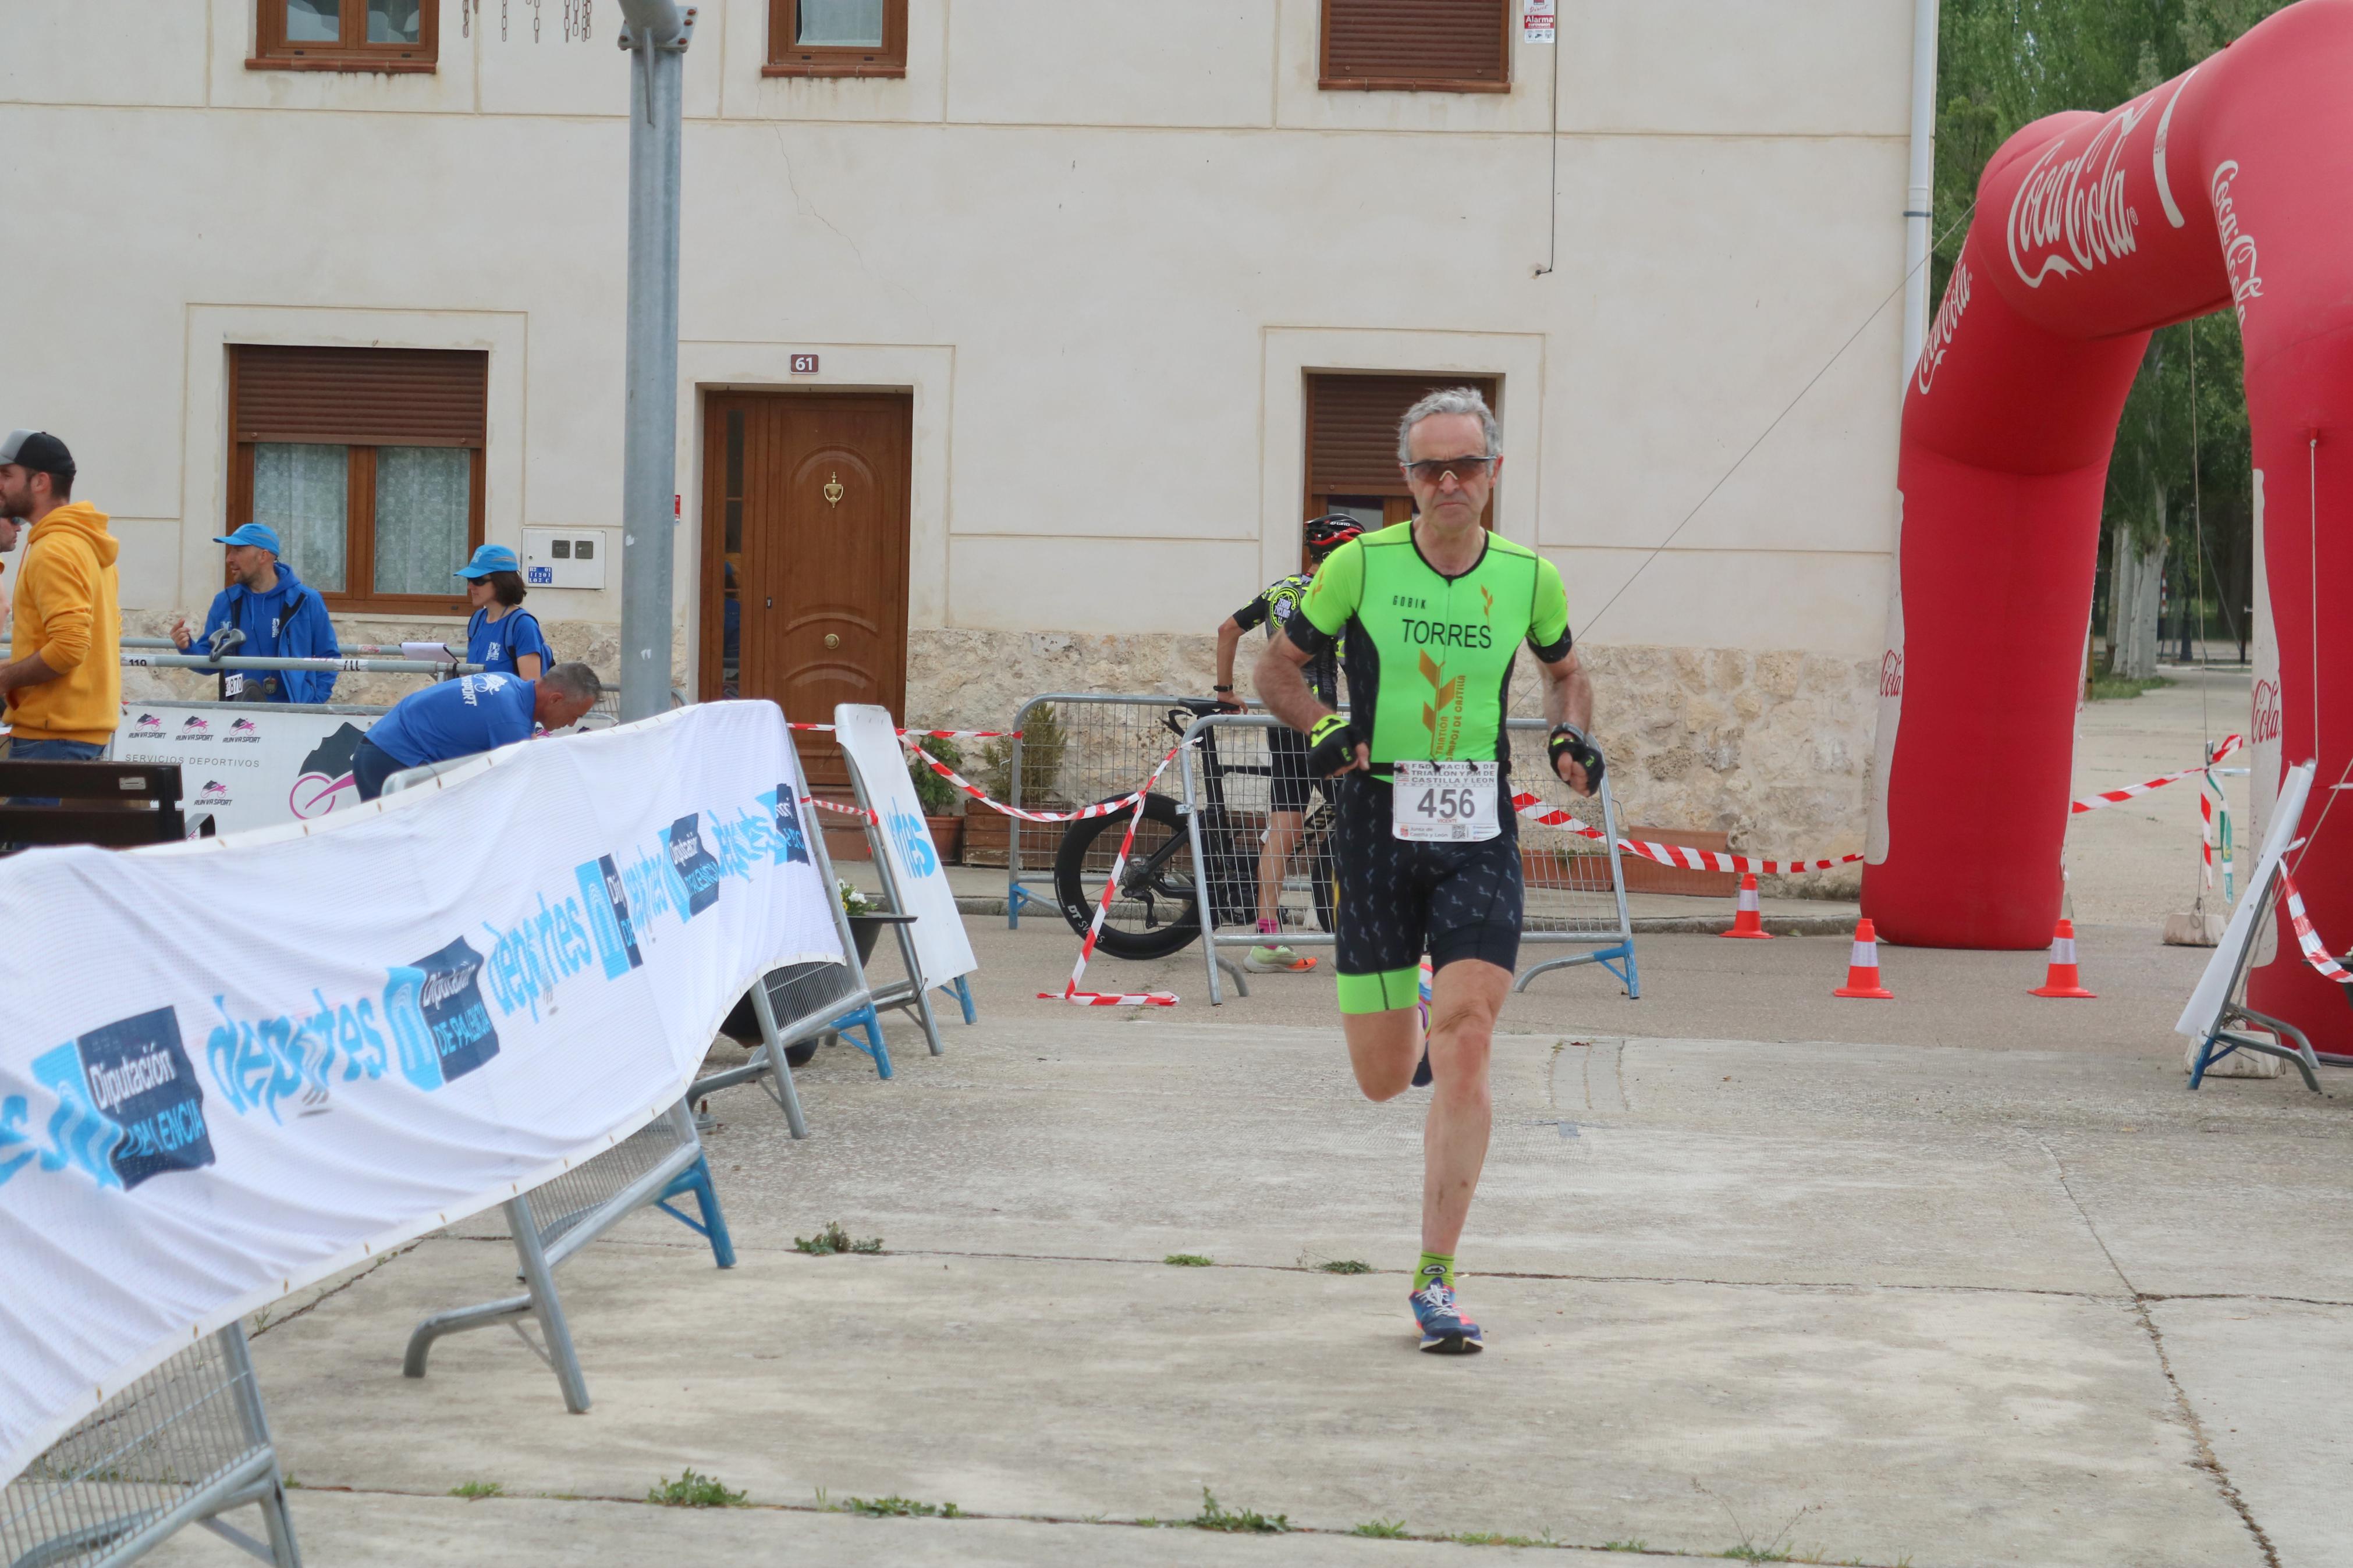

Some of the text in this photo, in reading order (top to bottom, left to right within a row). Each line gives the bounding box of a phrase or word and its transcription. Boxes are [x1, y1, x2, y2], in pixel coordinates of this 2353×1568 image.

[2007, 97, 2155, 289] Coca-Cola
[796, 357, 812, 371] 61
[1393, 595, 1426, 609] GOBIK
[1402, 618, 1492, 649] TORRES
[230, 676, 242, 694] 870
[1454, 675, 1466, 713] CASTILLA
[1453, 716, 1462, 728] DE
[125, 754, 260, 767] SERVICIOS DEPORTIVOS
[1417, 788, 1475, 819] 456
[1067, 905, 1083, 919] DT
[432, 1021, 457, 1058] DE
[88, 1042, 177, 1114] Diputación
